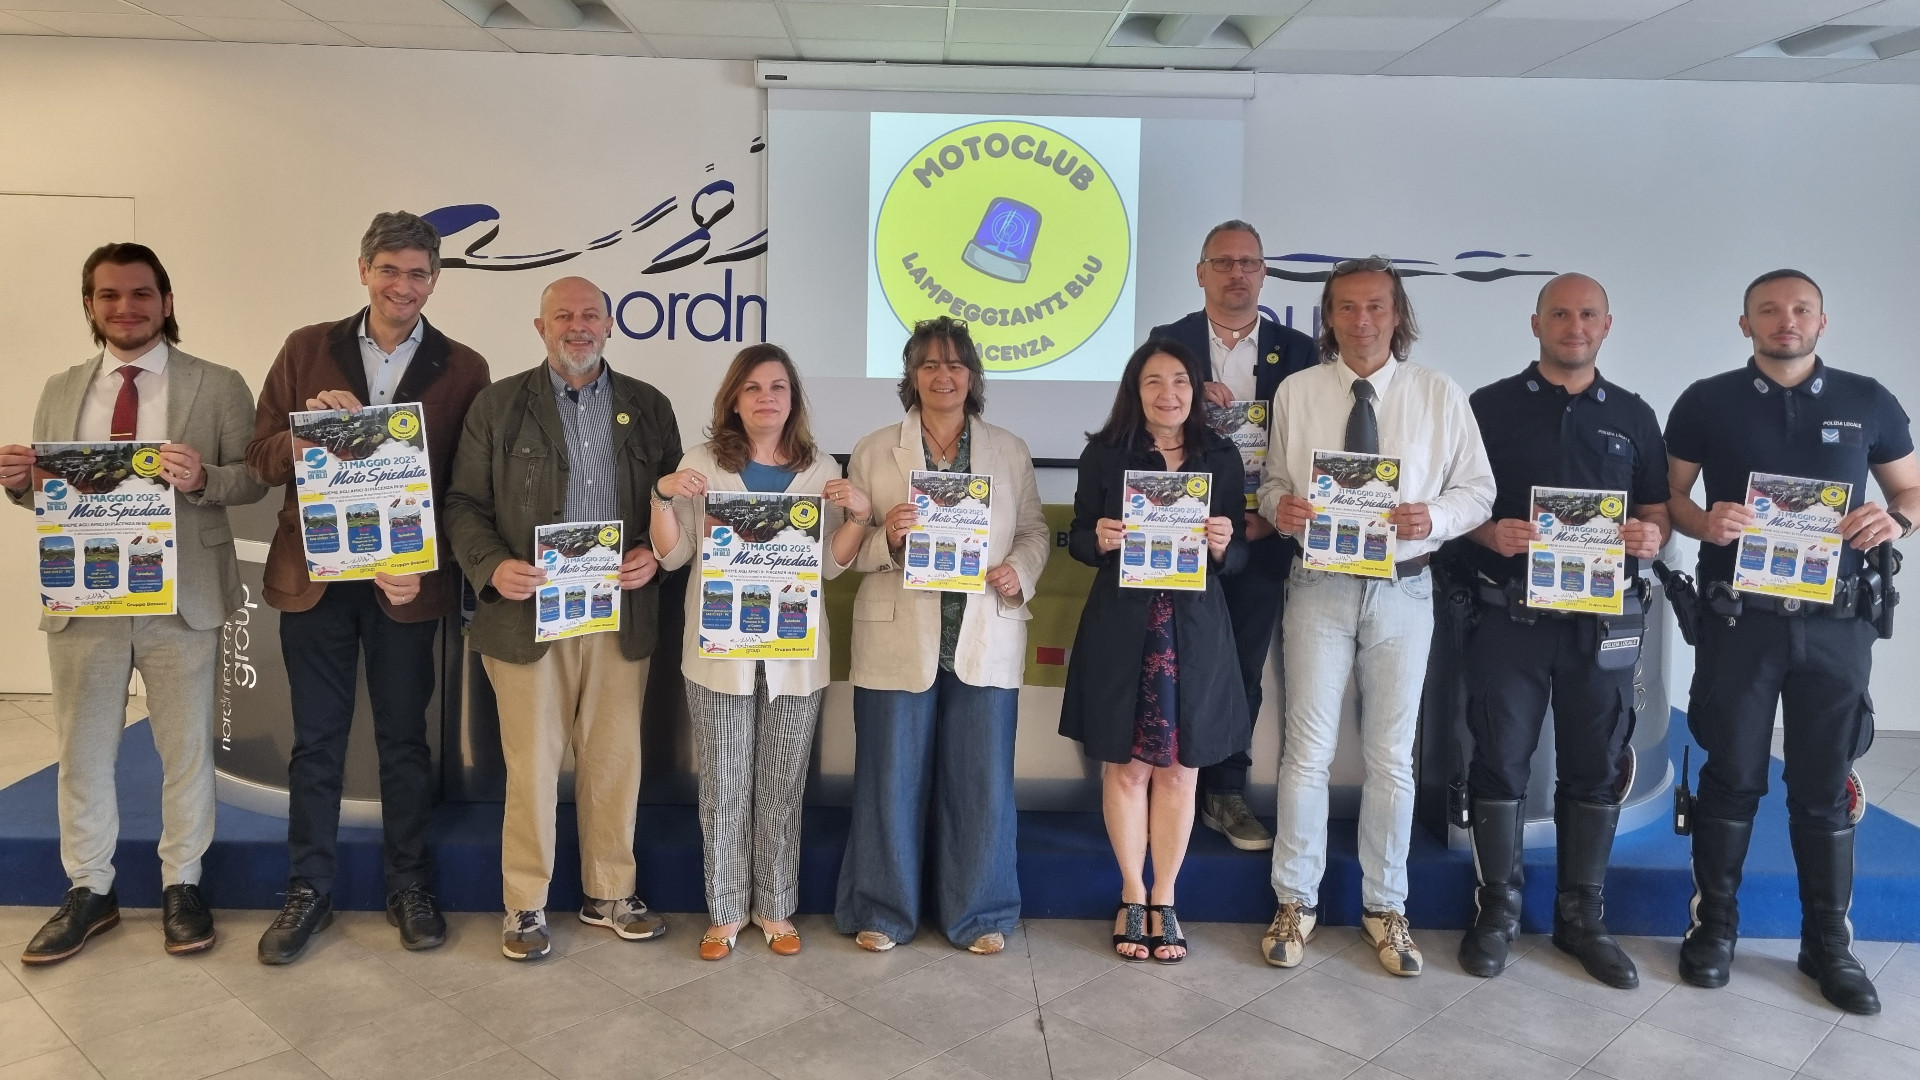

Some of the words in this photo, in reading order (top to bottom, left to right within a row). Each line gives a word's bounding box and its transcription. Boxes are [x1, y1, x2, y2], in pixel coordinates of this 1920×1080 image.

[912, 132, 1096, 192] MOTOCLUB
[902, 252, 1068, 326] LAMPEGGIANTI
[1065, 255, 1103, 299] BLU
[975, 334, 1055, 361] CENZA
[338, 461, 349, 470] 31
[350, 458, 391, 469] MAGGIO
[394, 456, 417, 464] 2025
[328, 470, 366, 487] Moto
[366, 464, 427, 486] Spiedata
[78, 495, 88, 503] 31
[90, 494, 133, 503] MAGGIO
[136, 493, 161, 502] 2025
[68, 504, 107, 520] Moto
[108, 502, 171, 521] Spiedata
[750, 543, 788, 552] MAGGIO
[730, 551, 764, 566] Moto
[764, 552, 818, 570] Spiedata
